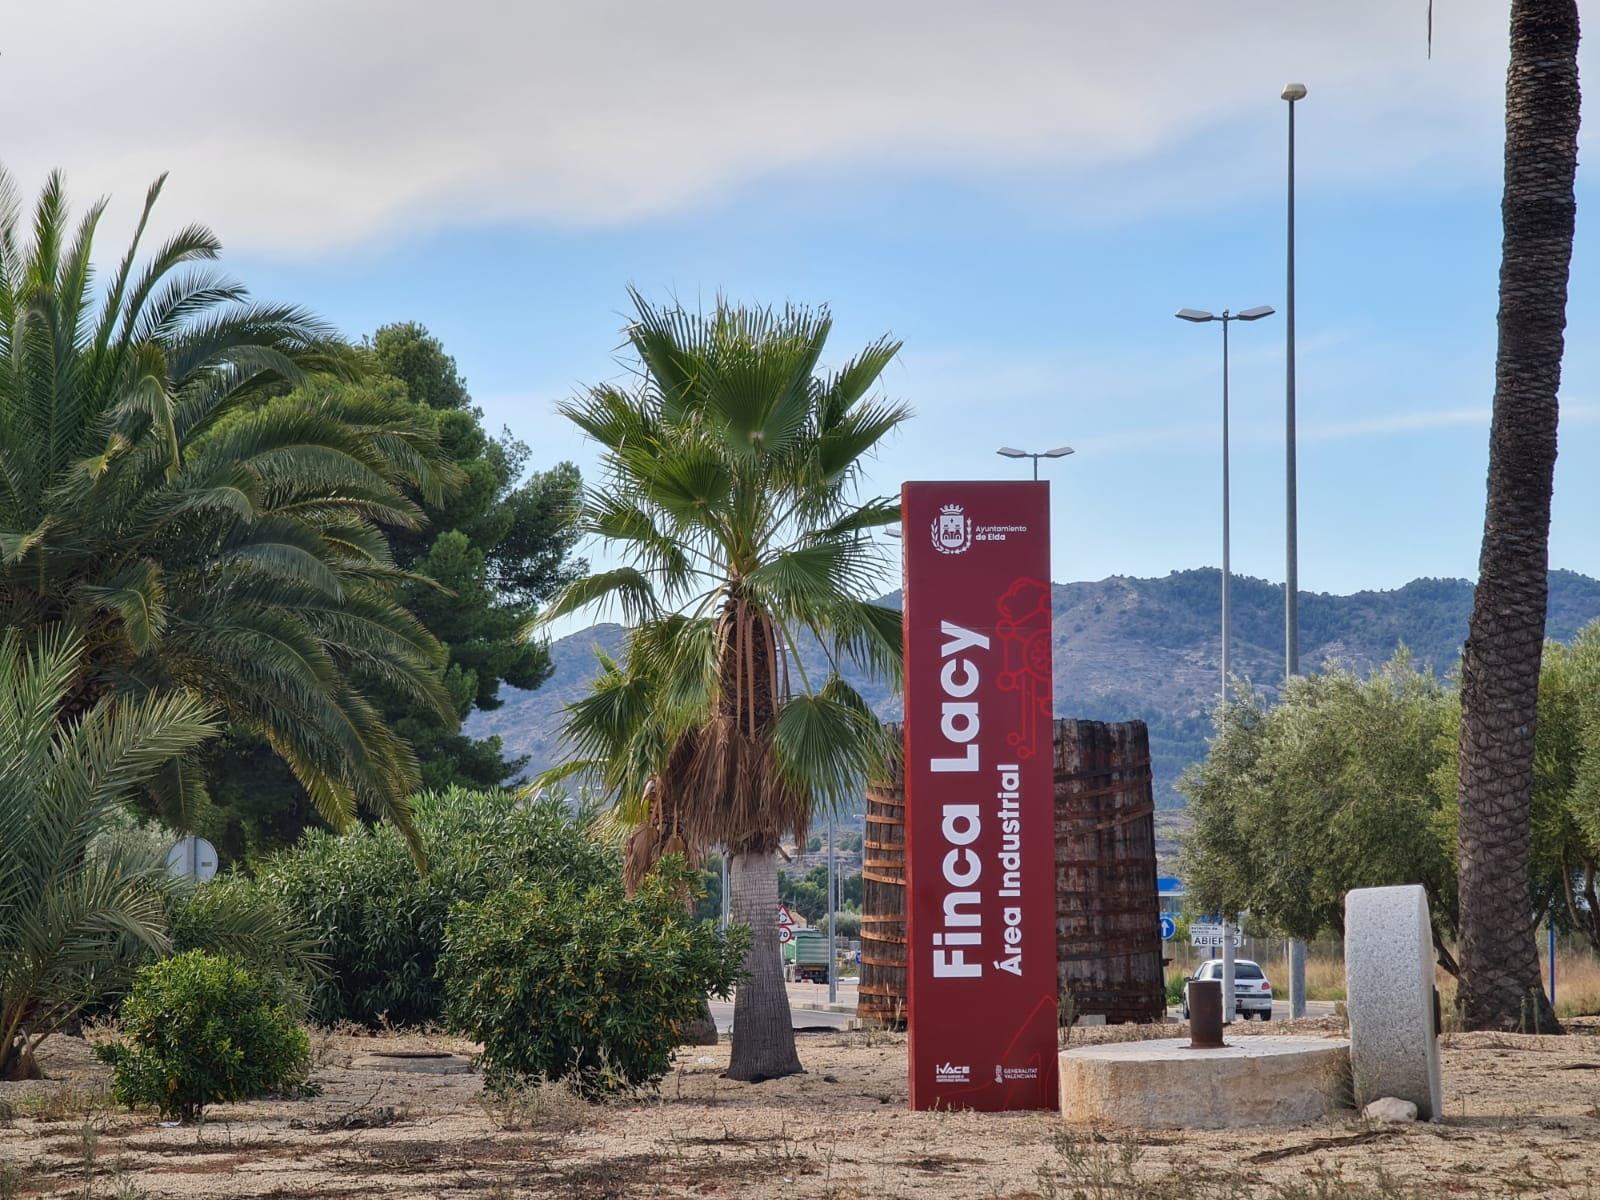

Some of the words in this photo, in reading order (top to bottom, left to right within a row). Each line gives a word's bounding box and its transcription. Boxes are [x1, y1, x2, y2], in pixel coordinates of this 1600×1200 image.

[975, 525, 1027, 533] Ayuntamiento
[976, 533, 986, 541] de
[987, 533, 1006, 541] Elda
[930, 620, 990, 772] Lacy
[997, 764, 1022, 897] Industrial
[933, 804, 983, 978] Finca
[993, 907, 1023, 977] Área
[1194, 936, 1239, 945] ABIERO
